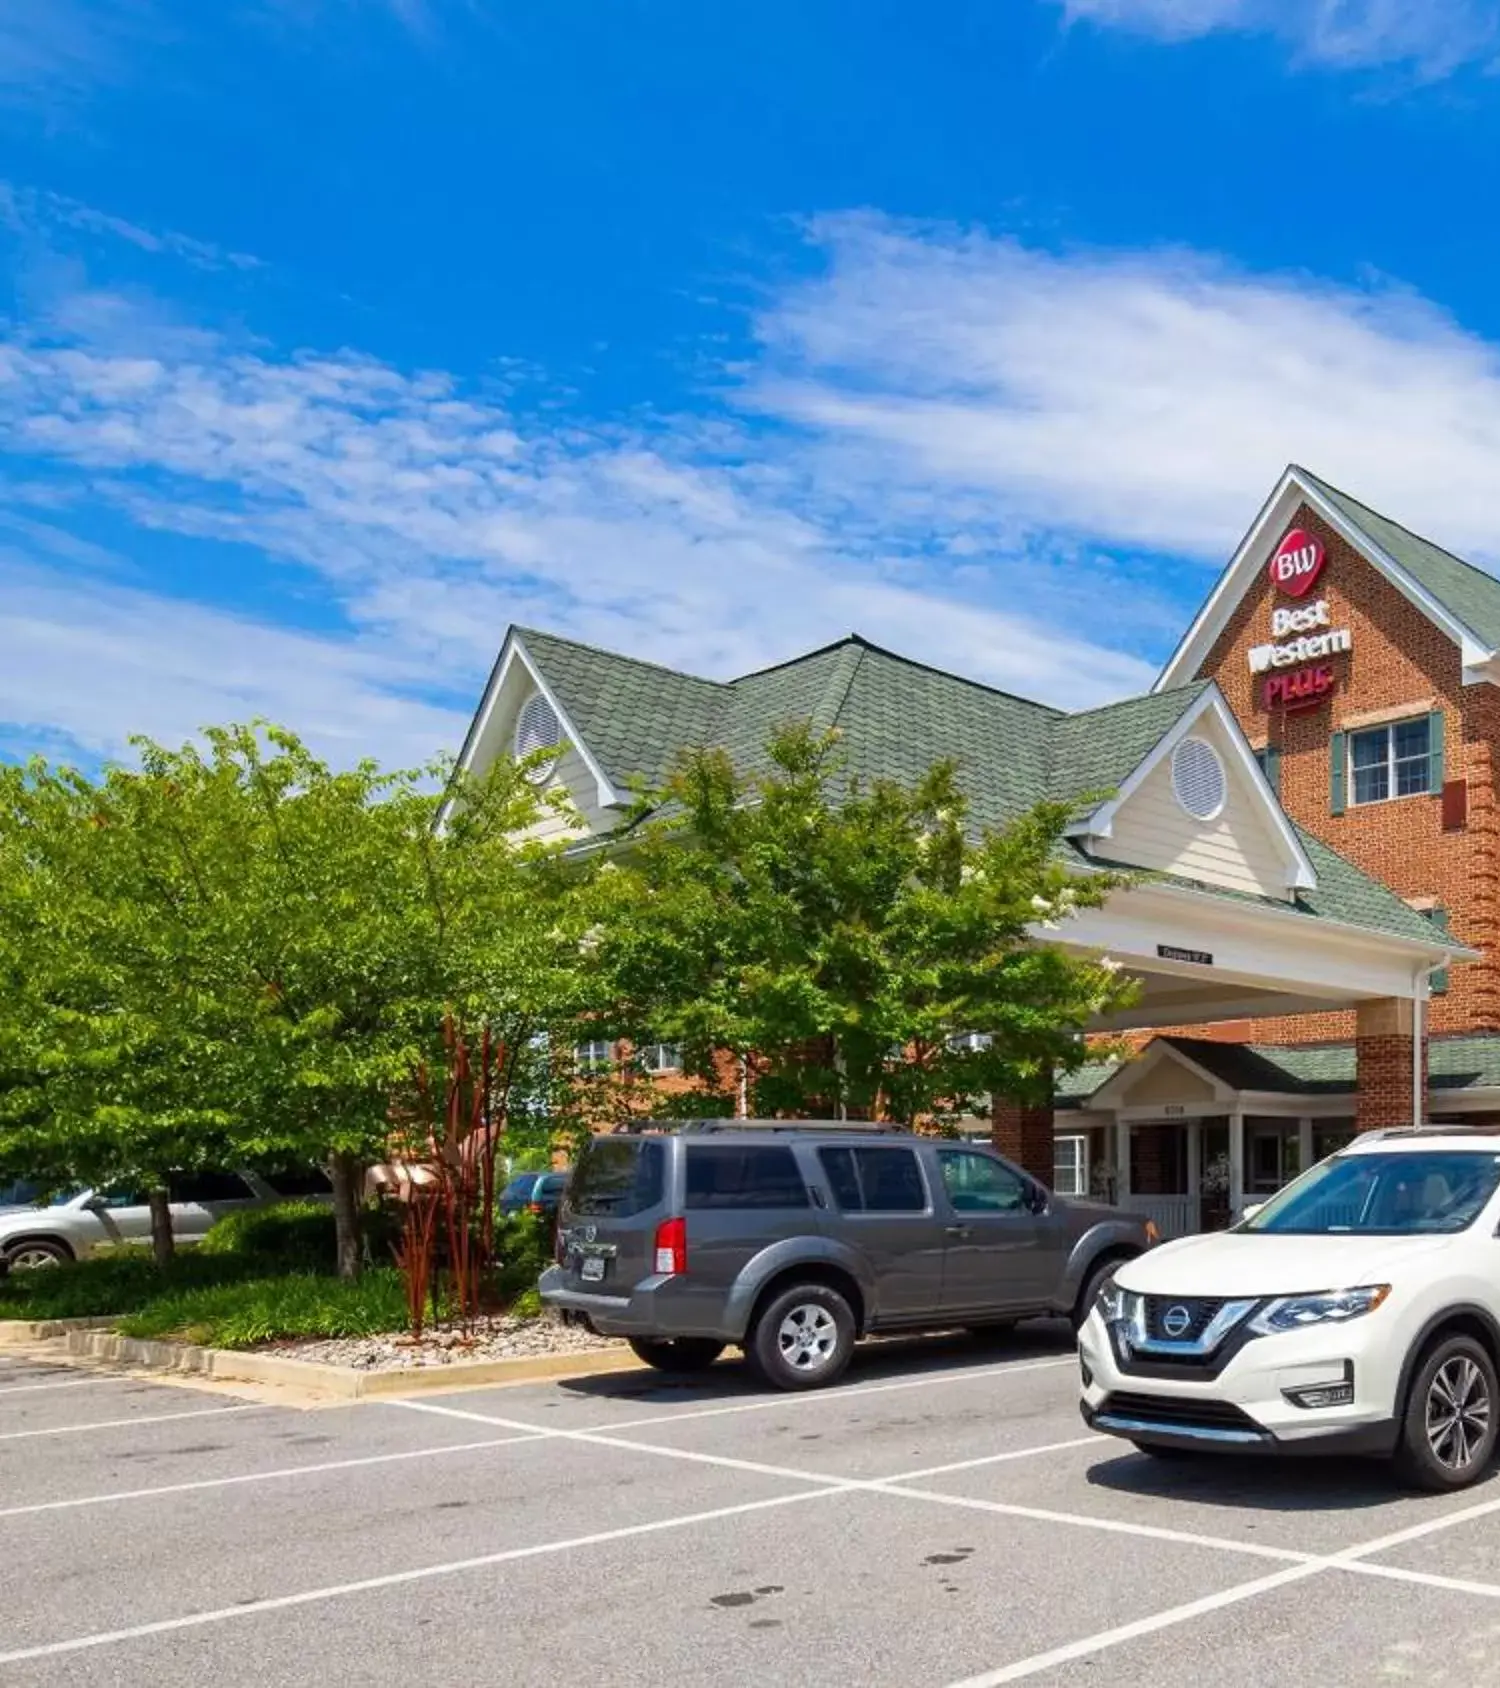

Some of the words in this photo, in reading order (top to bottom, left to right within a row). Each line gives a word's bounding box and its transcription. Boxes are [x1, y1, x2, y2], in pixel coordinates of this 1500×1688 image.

[1277, 545, 1316, 581] BW
[1272, 601, 1330, 637] Best
[1248, 628, 1352, 673] Western
[1262, 665, 1334, 710] PLUS
